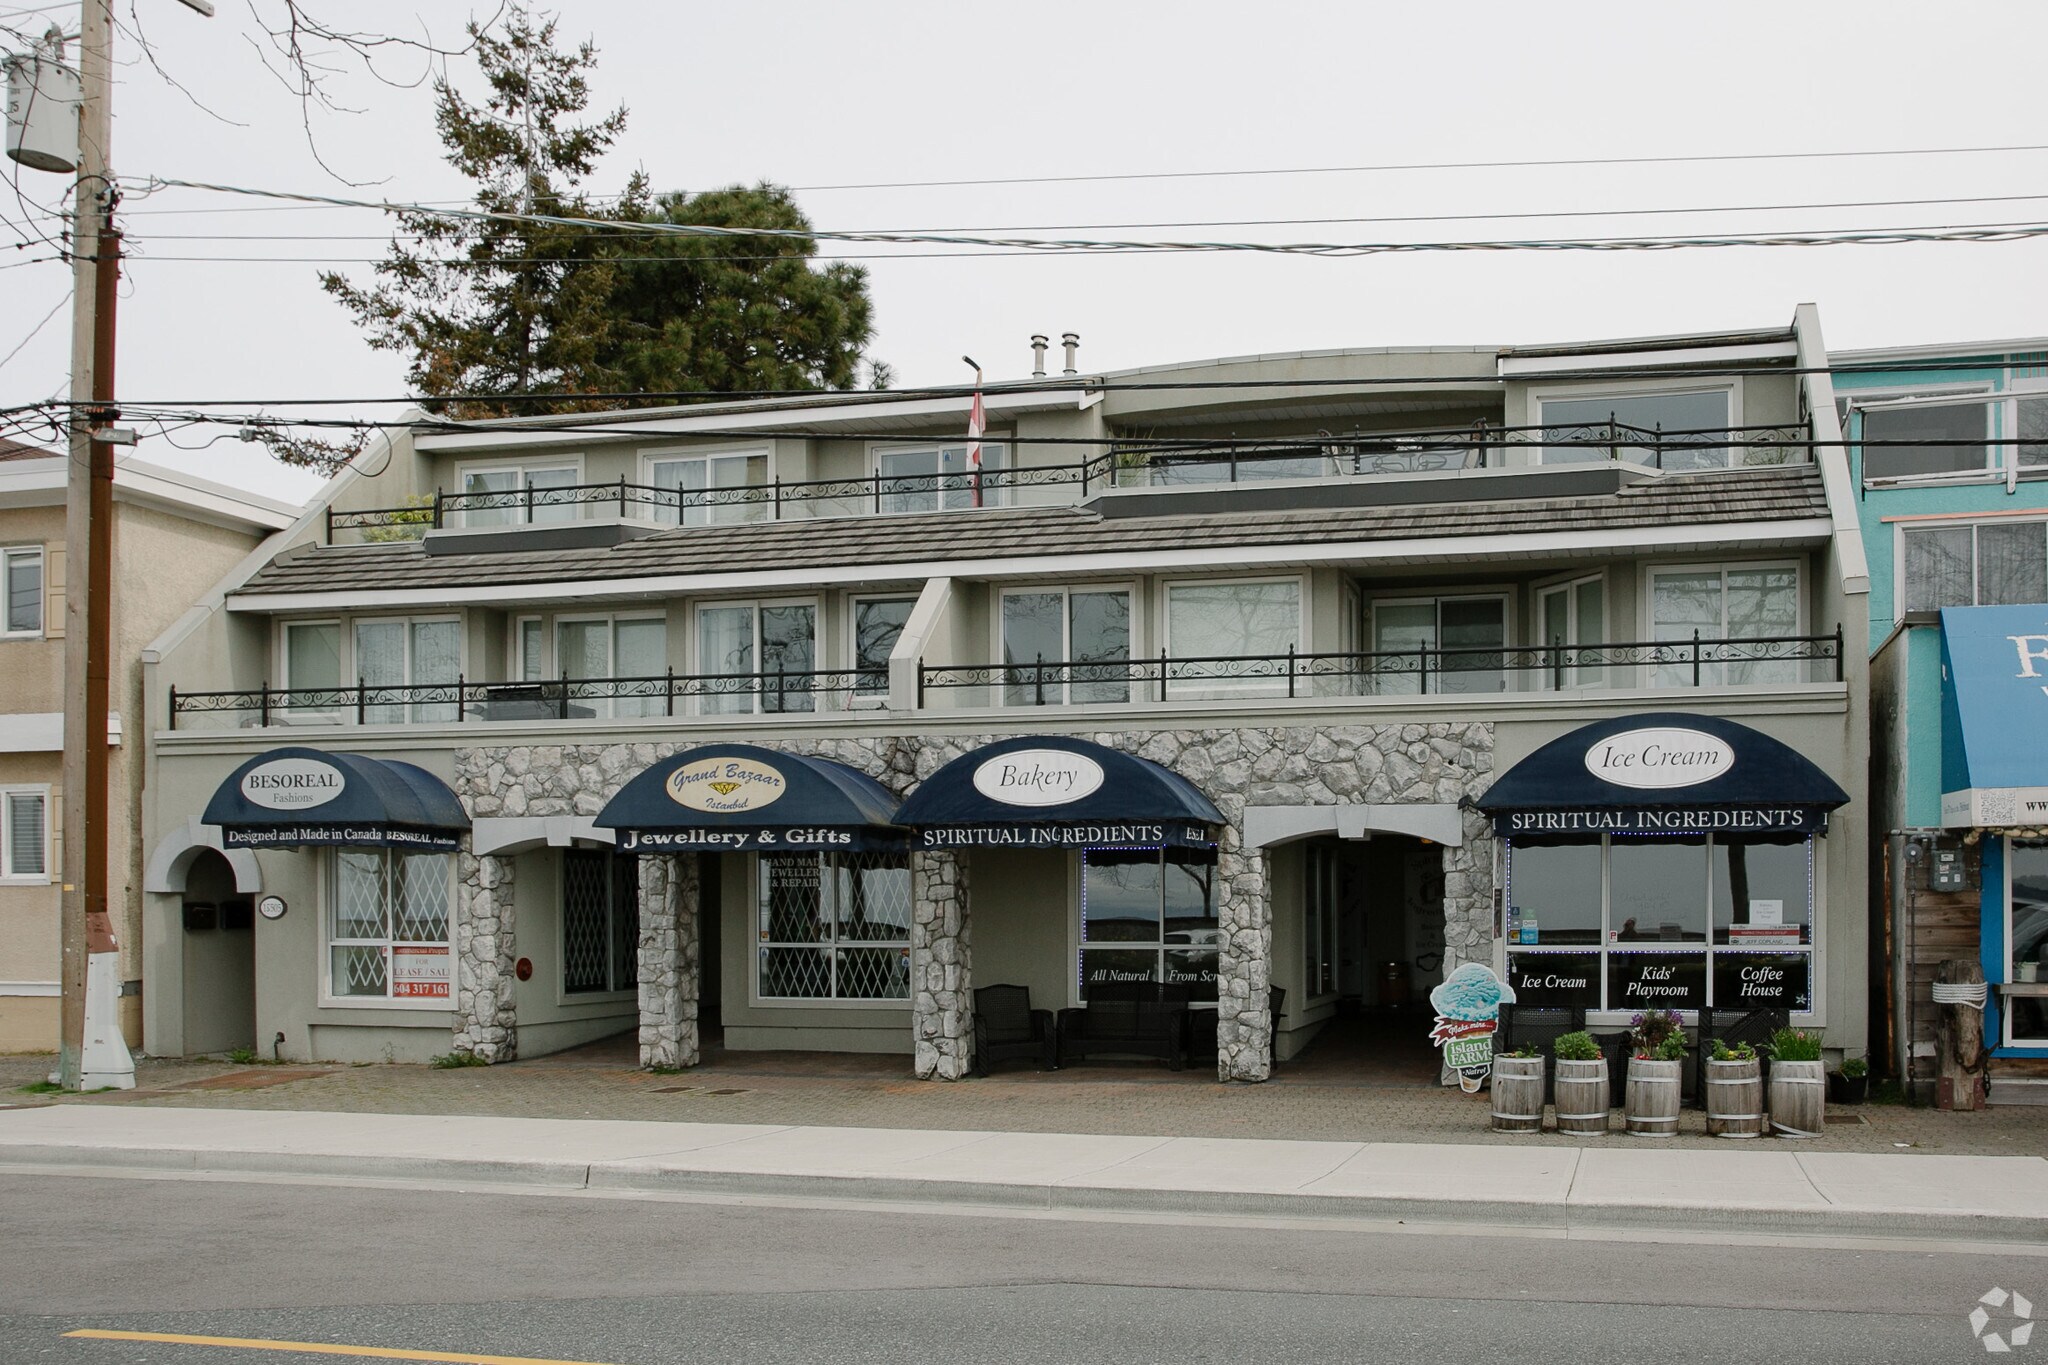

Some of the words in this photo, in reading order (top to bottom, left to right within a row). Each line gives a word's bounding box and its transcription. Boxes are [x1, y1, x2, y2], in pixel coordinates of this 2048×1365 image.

[1601, 745, 1635, 768] Ice
[1641, 743, 1719, 768] Cream
[249, 773, 338, 789] BESOREAL
[673, 766, 718, 792] Grand
[725, 763, 780, 787] Bazaar
[1000, 763, 1078, 792] Bakery
[273, 792, 313, 803] Fashions
[705, 797, 749, 810] Istanbul
[1512, 811, 1630, 830] SPIRITUAL
[1637, 809, 1804, 828] INGREDIENTS
[228, 828, 277, 844] Designed
[279, 828, 298, 840] and
[300, 828, 330, 840] Made
[331, 828, 342, 840] in
[344, 827, 382, 840] Canada
[386, 830, 432, 843] BESOREAL
[624, 829, 750, 849] Jewellery
[757, 829, 776, 844] &
[785, 828, 851, 844] Gifts
[923, 827, 1026, 846] SPIRITUAL
[1030, 825, 1163, 844] INGREDIENTS
[394, 967, 423, 976] LEASE
[1090, 969, 1106, 982] All
[1109, 969, 1150, 982] Natural
[1168, 969, 1198, 982] From
[1640, 966, 1676, 980] Kids'
[1740, 966, 1784, 984] Coffee
[394, 983, 410, 994] 604
[412, 983, 429, 994] 317
[1521, 974, 1541, 988] Ice
[1545, 974, 1587, 988] Cream
[1626, 982, 1689, 999] Playroom
[1740, 983, 1783, 997] House
[1451, 1039, 1492, 1054] island
